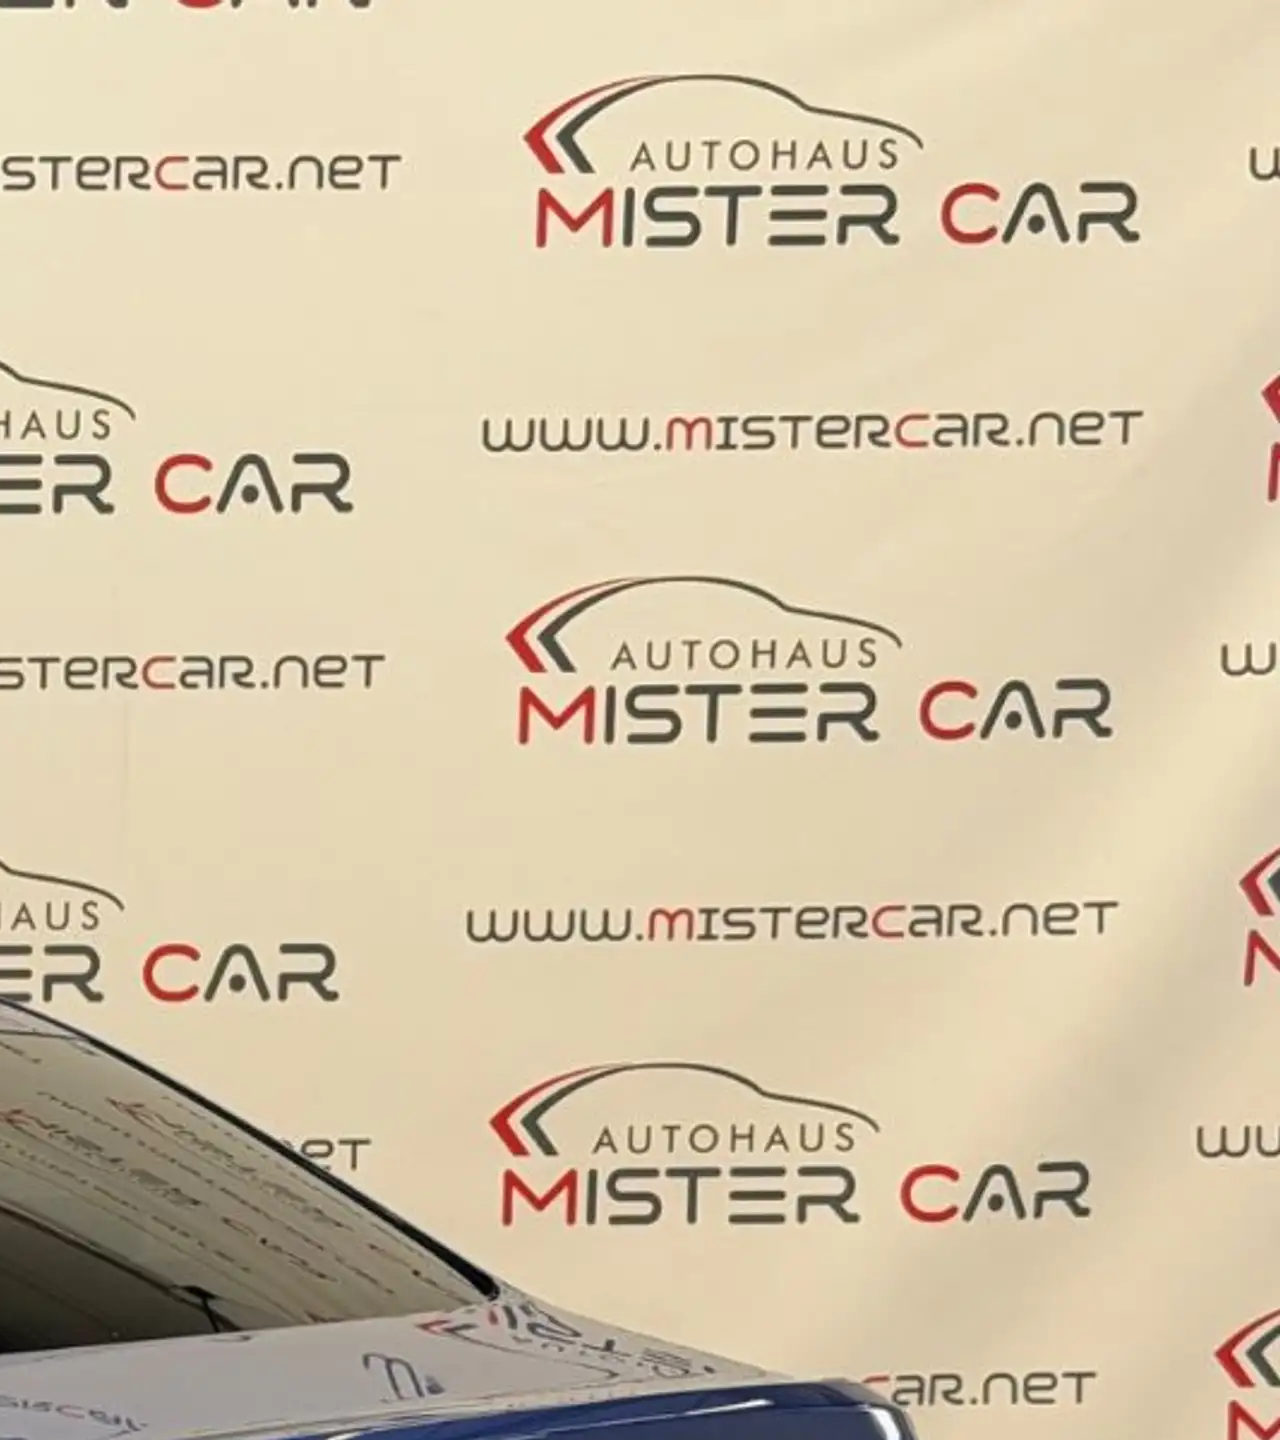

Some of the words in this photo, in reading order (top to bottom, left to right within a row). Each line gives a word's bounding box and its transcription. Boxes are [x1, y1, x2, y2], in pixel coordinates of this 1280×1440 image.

[629, 137, 898, 172] AUTOHAUS
[535, 183, 900, 249] MISTER
[940, 181, 1141, 245] CAR
[154, 452, 354, 515] CAR
[610, 637, 877, 671] AUTOHAUS
[518, 681, 881, 746] MISTER
[919, 678, 1113, 741] CAR
[142, 943, 340, 1003] CAR
[591, 1122, 855, 1155] AUTOHAUS
[501, 1165, 860, 1227] MISTER
[900, 1161, 1091, 1223] CAR
